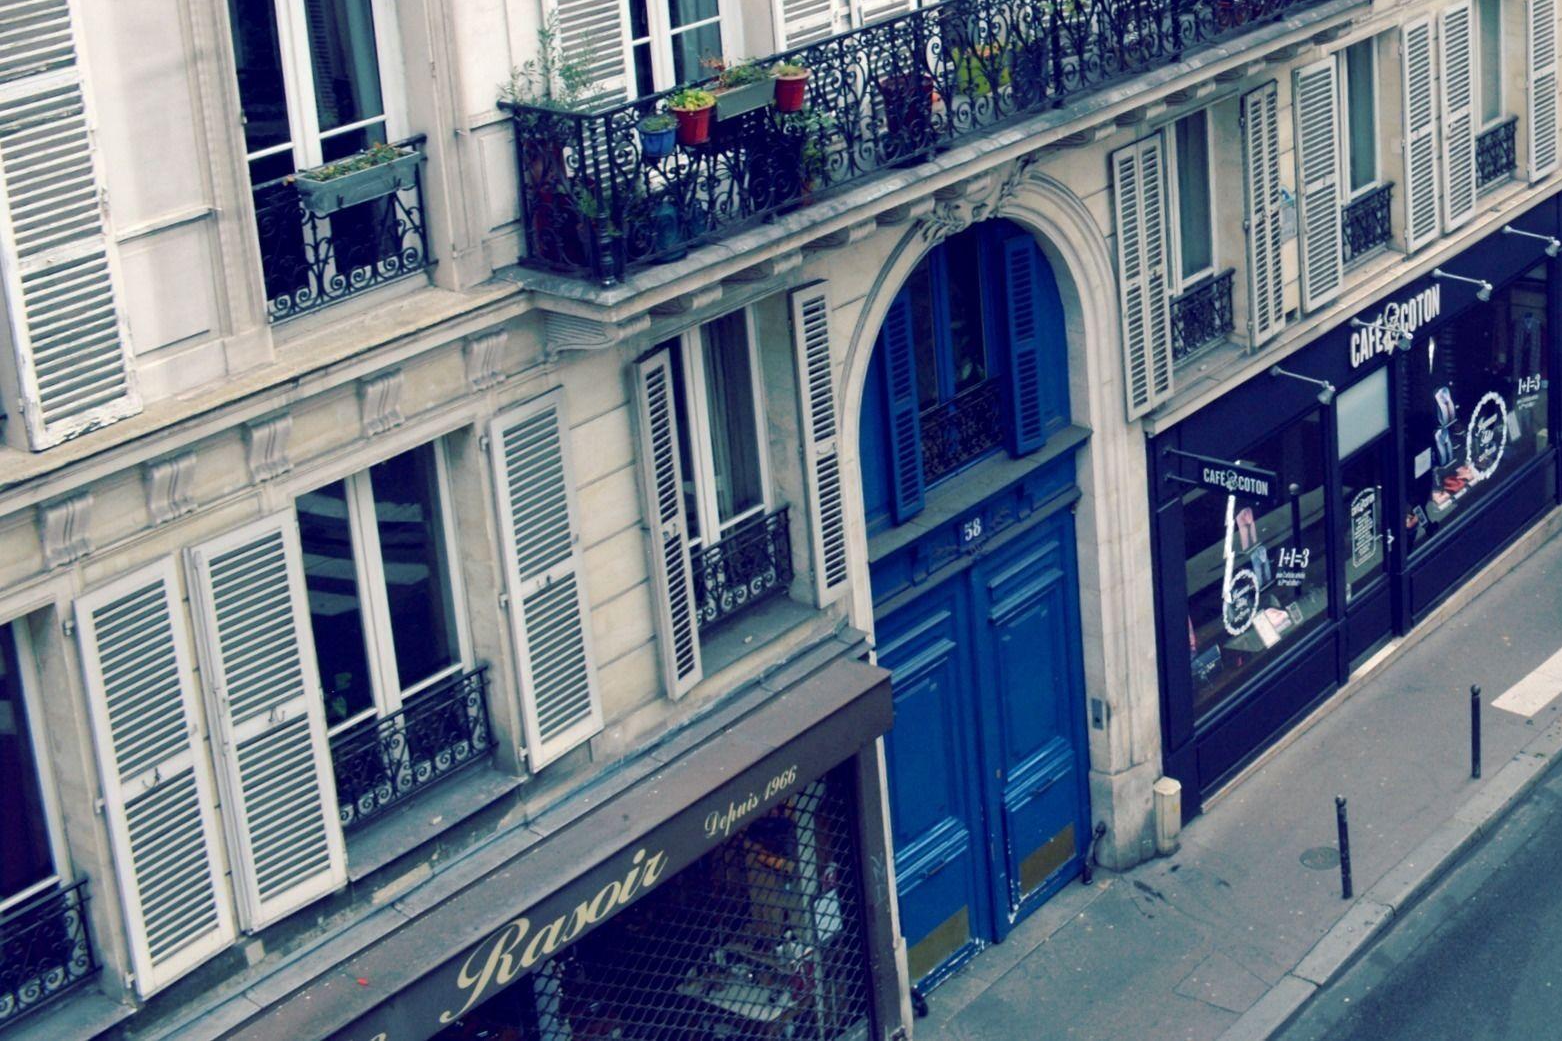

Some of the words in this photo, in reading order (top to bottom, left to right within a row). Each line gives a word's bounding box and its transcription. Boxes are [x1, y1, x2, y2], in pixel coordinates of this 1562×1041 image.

[1351, 313, 1384, 368] CAFÉ
[1400, 283, 1440, 335] COTON
[1517, 373, 1541, 395] 1+1=3
[1238, 475, 1268, 496] COTON
[964, 517, 981, 541] 58
[1278, 547, 1310, 568] 1+1=3
[704, 791, 759, 839] Depuis
[764, 764, 798, 801] 1966
[439, 848, 669, 1024] Rasoir
